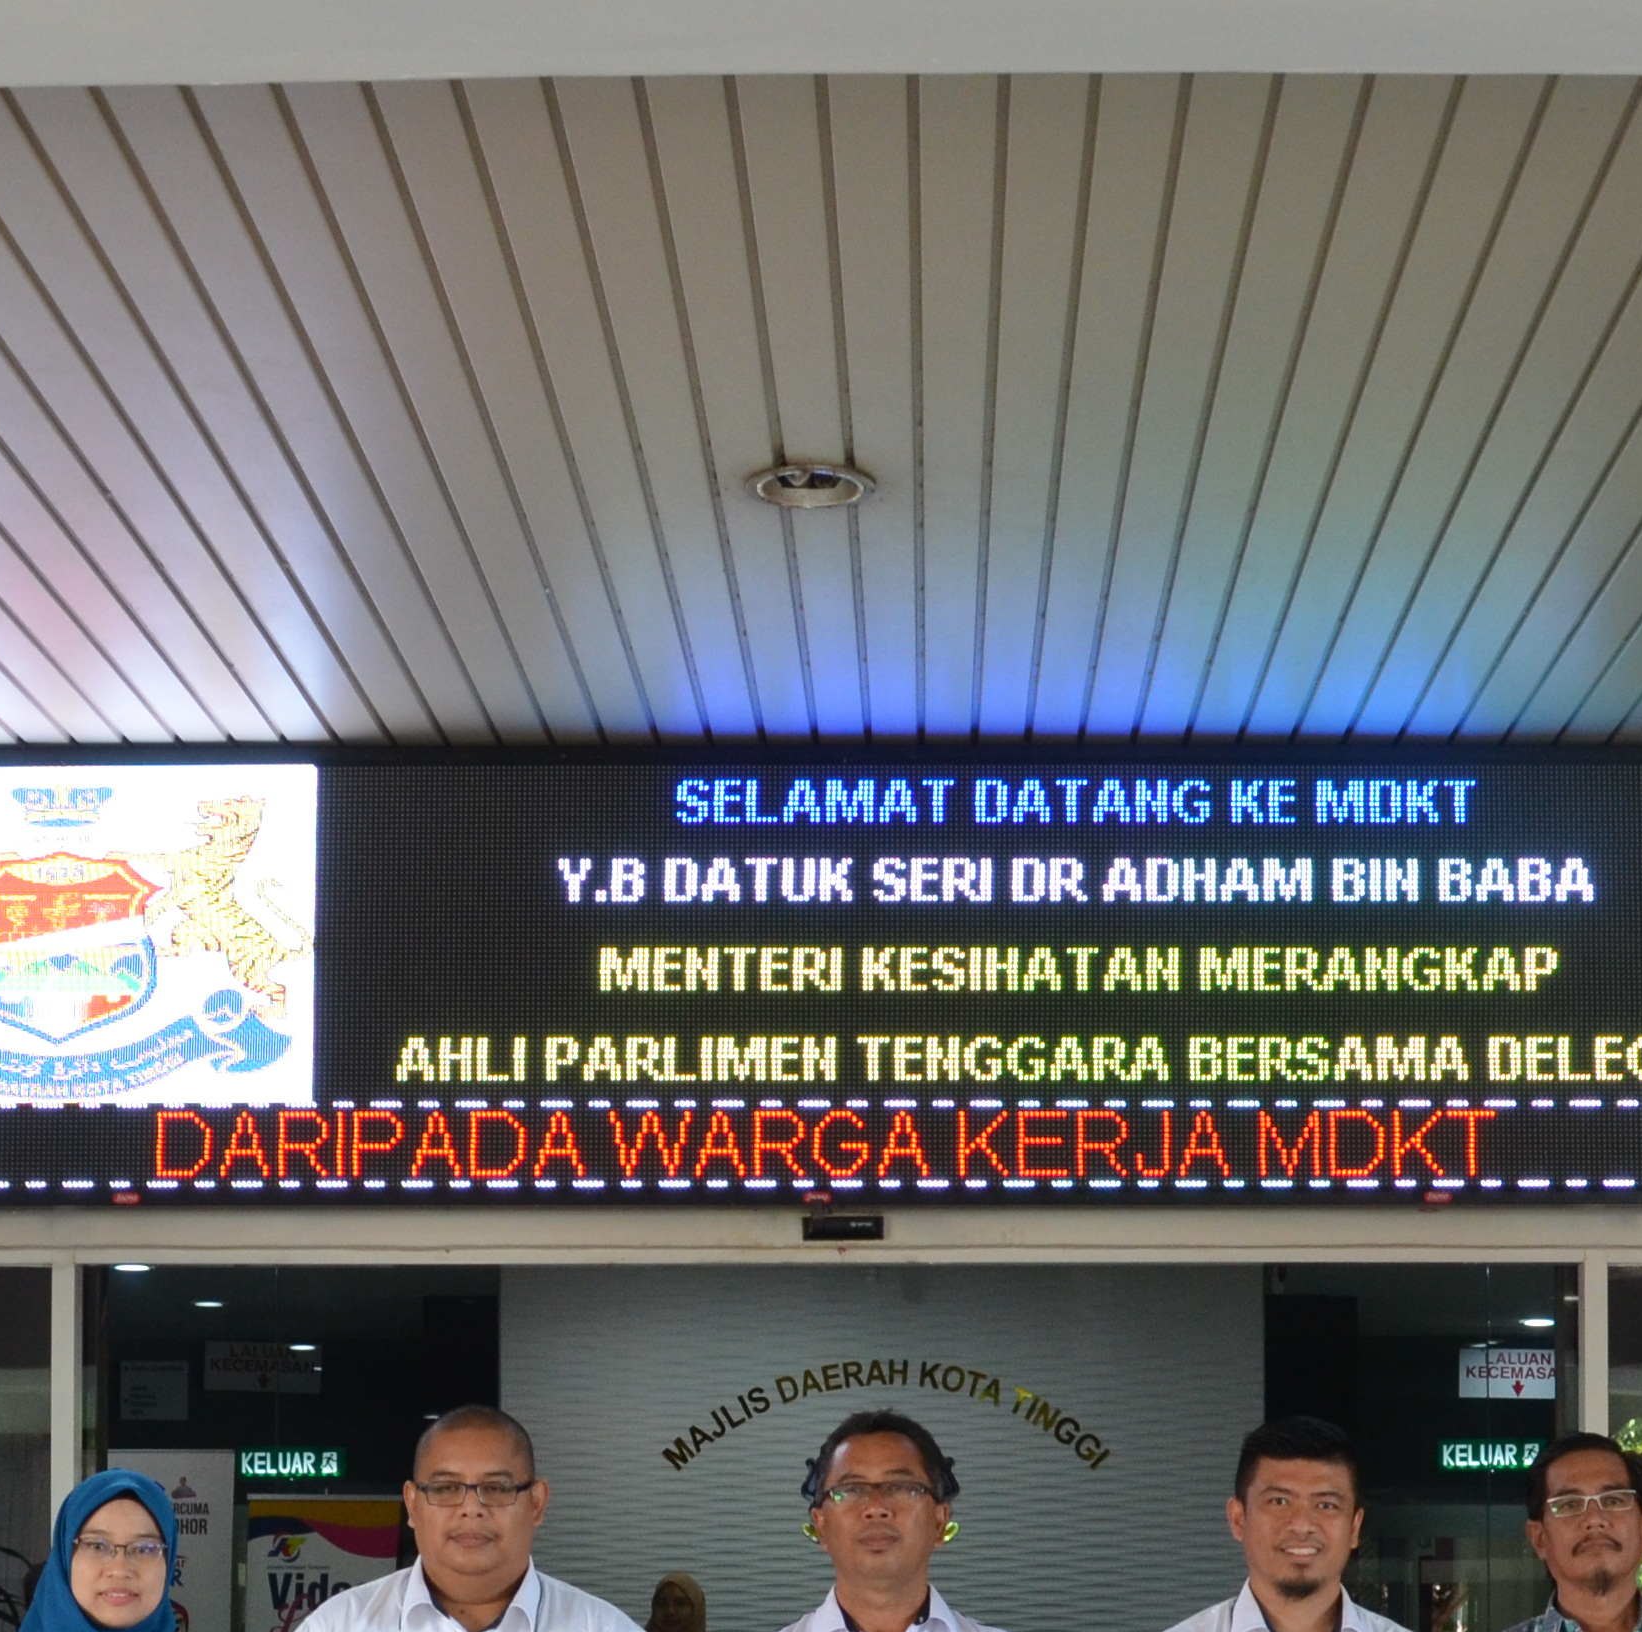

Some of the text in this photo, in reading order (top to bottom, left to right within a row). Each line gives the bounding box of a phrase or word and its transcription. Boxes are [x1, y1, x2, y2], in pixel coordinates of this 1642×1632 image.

[674, 776, 1478, 826] SELAMAT DATANG KE MDKT
[557, 856, 1597, 904] Y.B DATUK SERI DR ADHAM BIN BABA
[598, 947, 1558, 992] MENTERI KESIHATAN MERANGKAP
[396, 1036, 526, 1082] AHLI
[544, 1036, 837, 1082] PARLIMEN
[857, 1035, 1169, 1081] TENGGARA
[1188, 1035, 1469, 1081] BERSAMA
[155, 1109, 1497, 1178] DARIPADA WARGA KERJA MDKT
[210, 1358, 316, 1374] KECEMASAN
[1485, 1353, 1552, 1366] LALUAN
[661, 1360, 1110, 1470] MAJLIS DAERAH KOTA TINGGI
[241, 1452, 315, 1475] KELUAR
[1443, 1443, 1518, 1467] KELUAR
